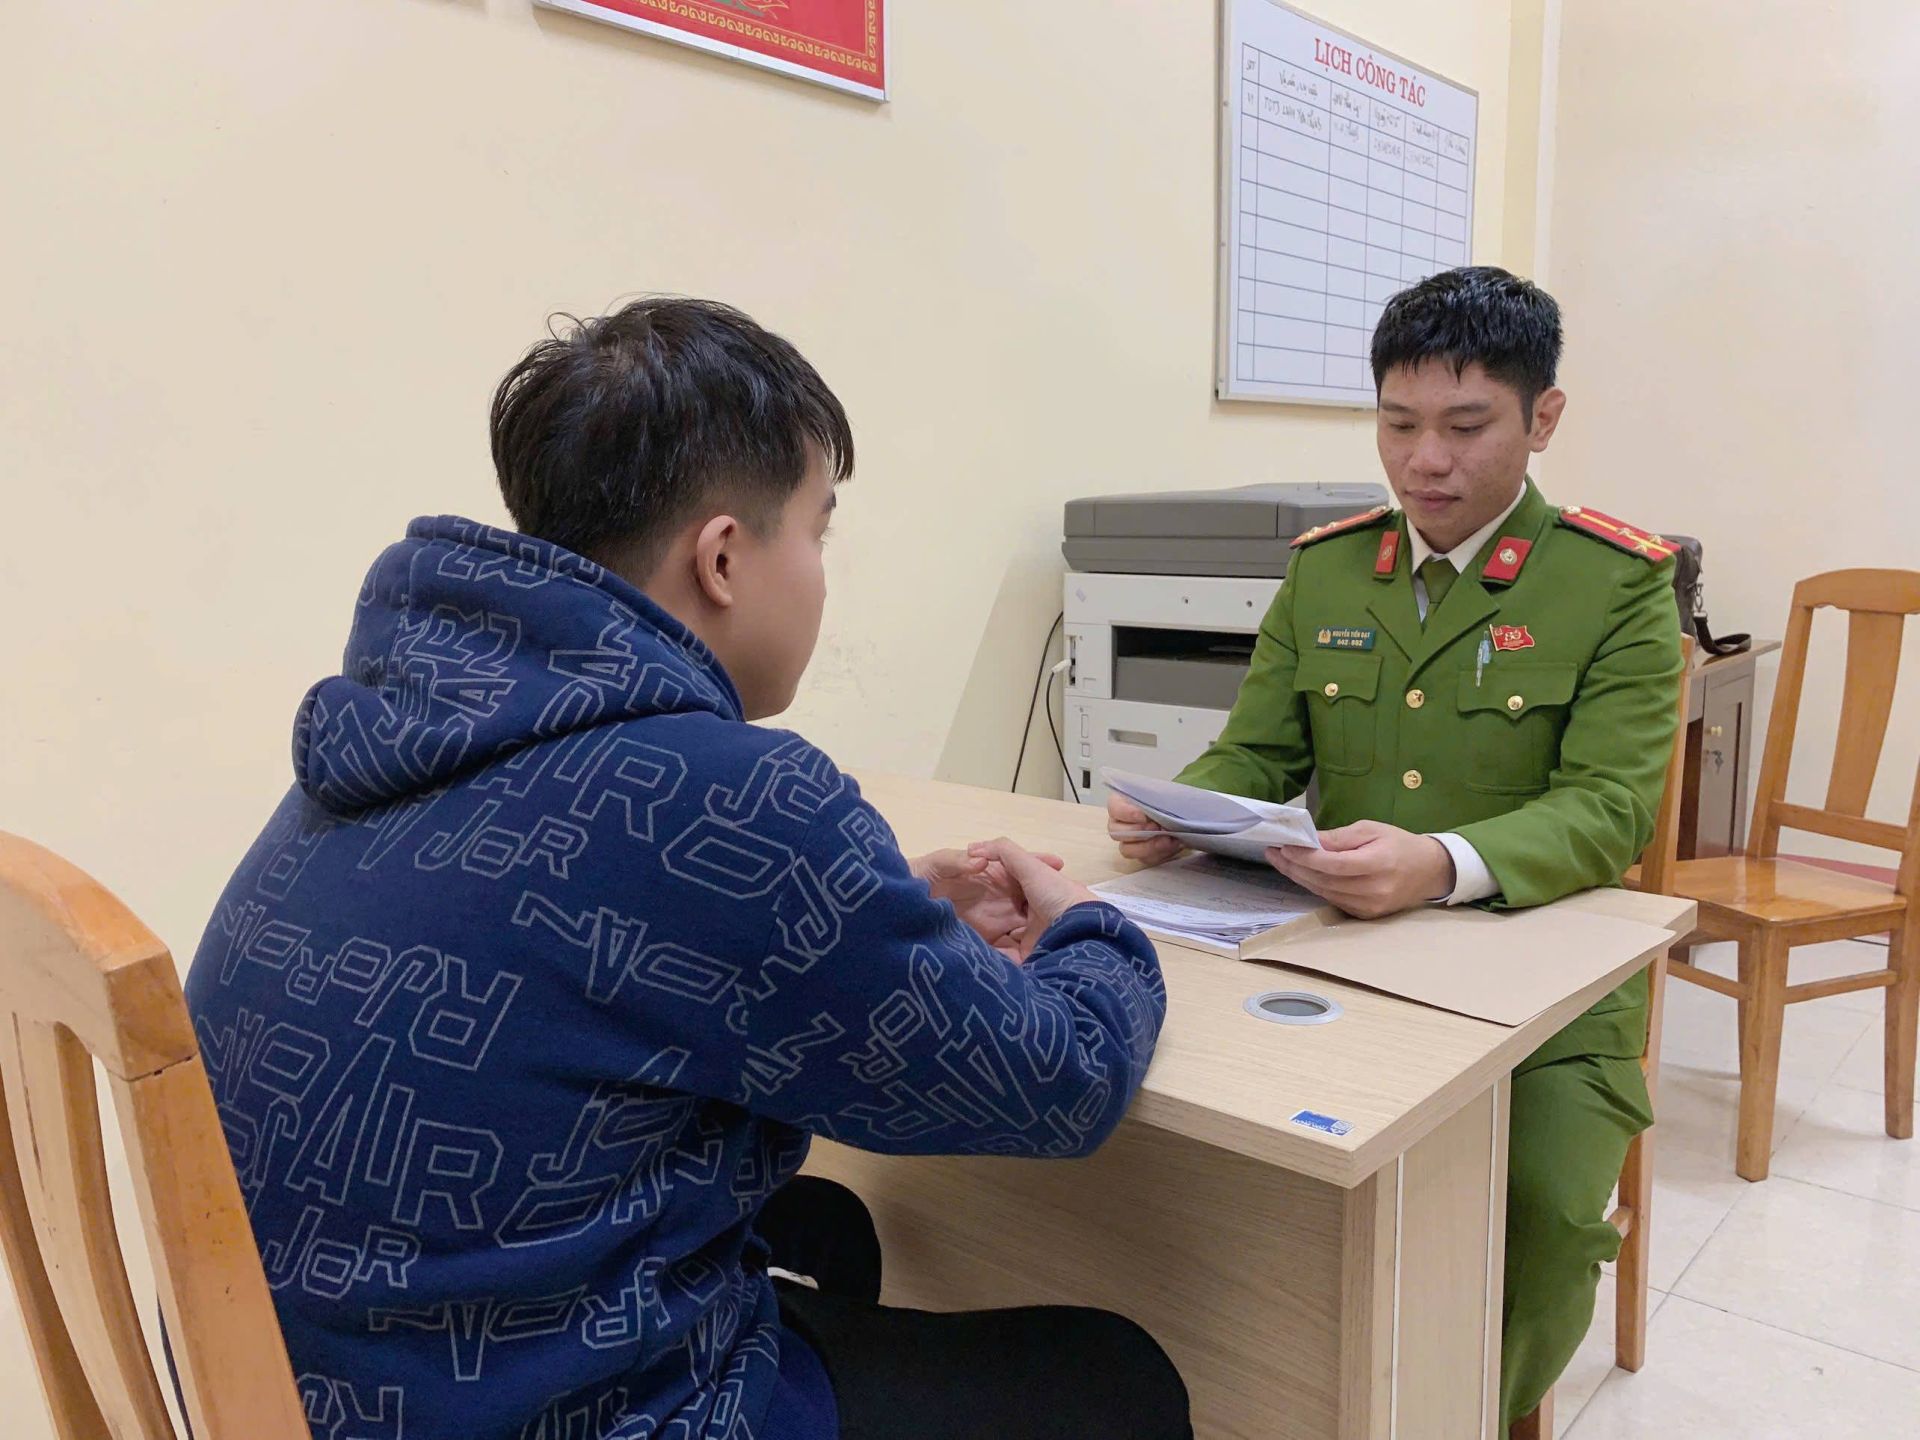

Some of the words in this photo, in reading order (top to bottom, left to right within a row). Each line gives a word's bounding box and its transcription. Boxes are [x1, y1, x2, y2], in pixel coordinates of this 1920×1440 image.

[1314, 38, 1352, 77] LỊCH
[1356, 54, 1396, 94] CÔNG
[1400, 75, 1426, 107] TÁC
